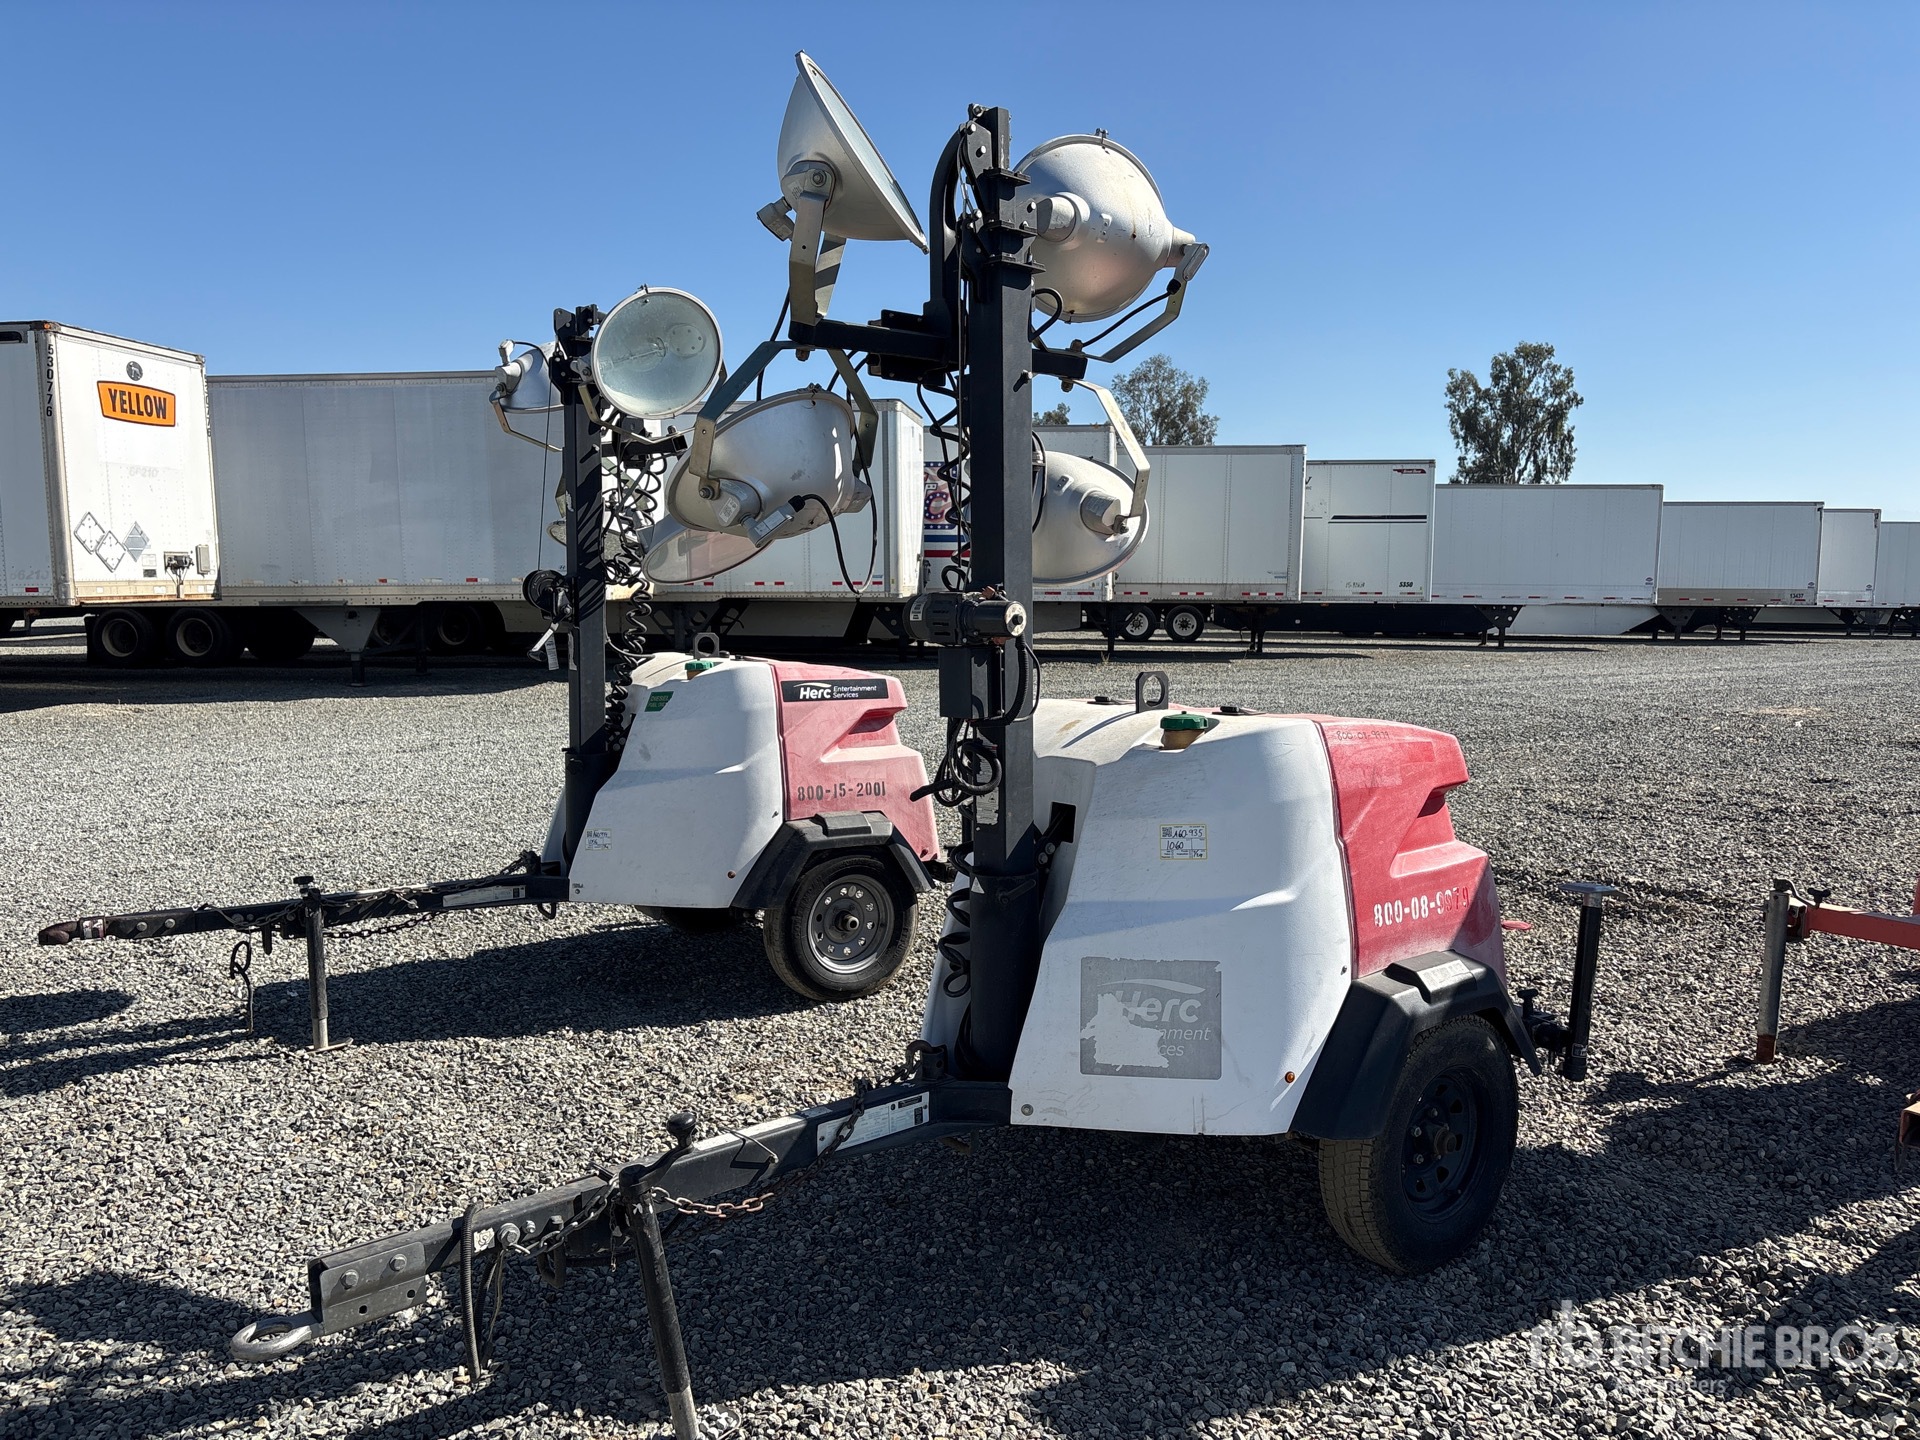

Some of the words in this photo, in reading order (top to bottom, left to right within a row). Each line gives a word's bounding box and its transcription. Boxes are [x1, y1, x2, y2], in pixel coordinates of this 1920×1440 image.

[46, 343, 54, 417] 530776
[107, 388, 167, 420] YELLOW
[799, 686, 831, 700] Herc
[797, 781, 886, 801] 800-15-2001
[1373, 886, 1470, 928] 800-08-9979
